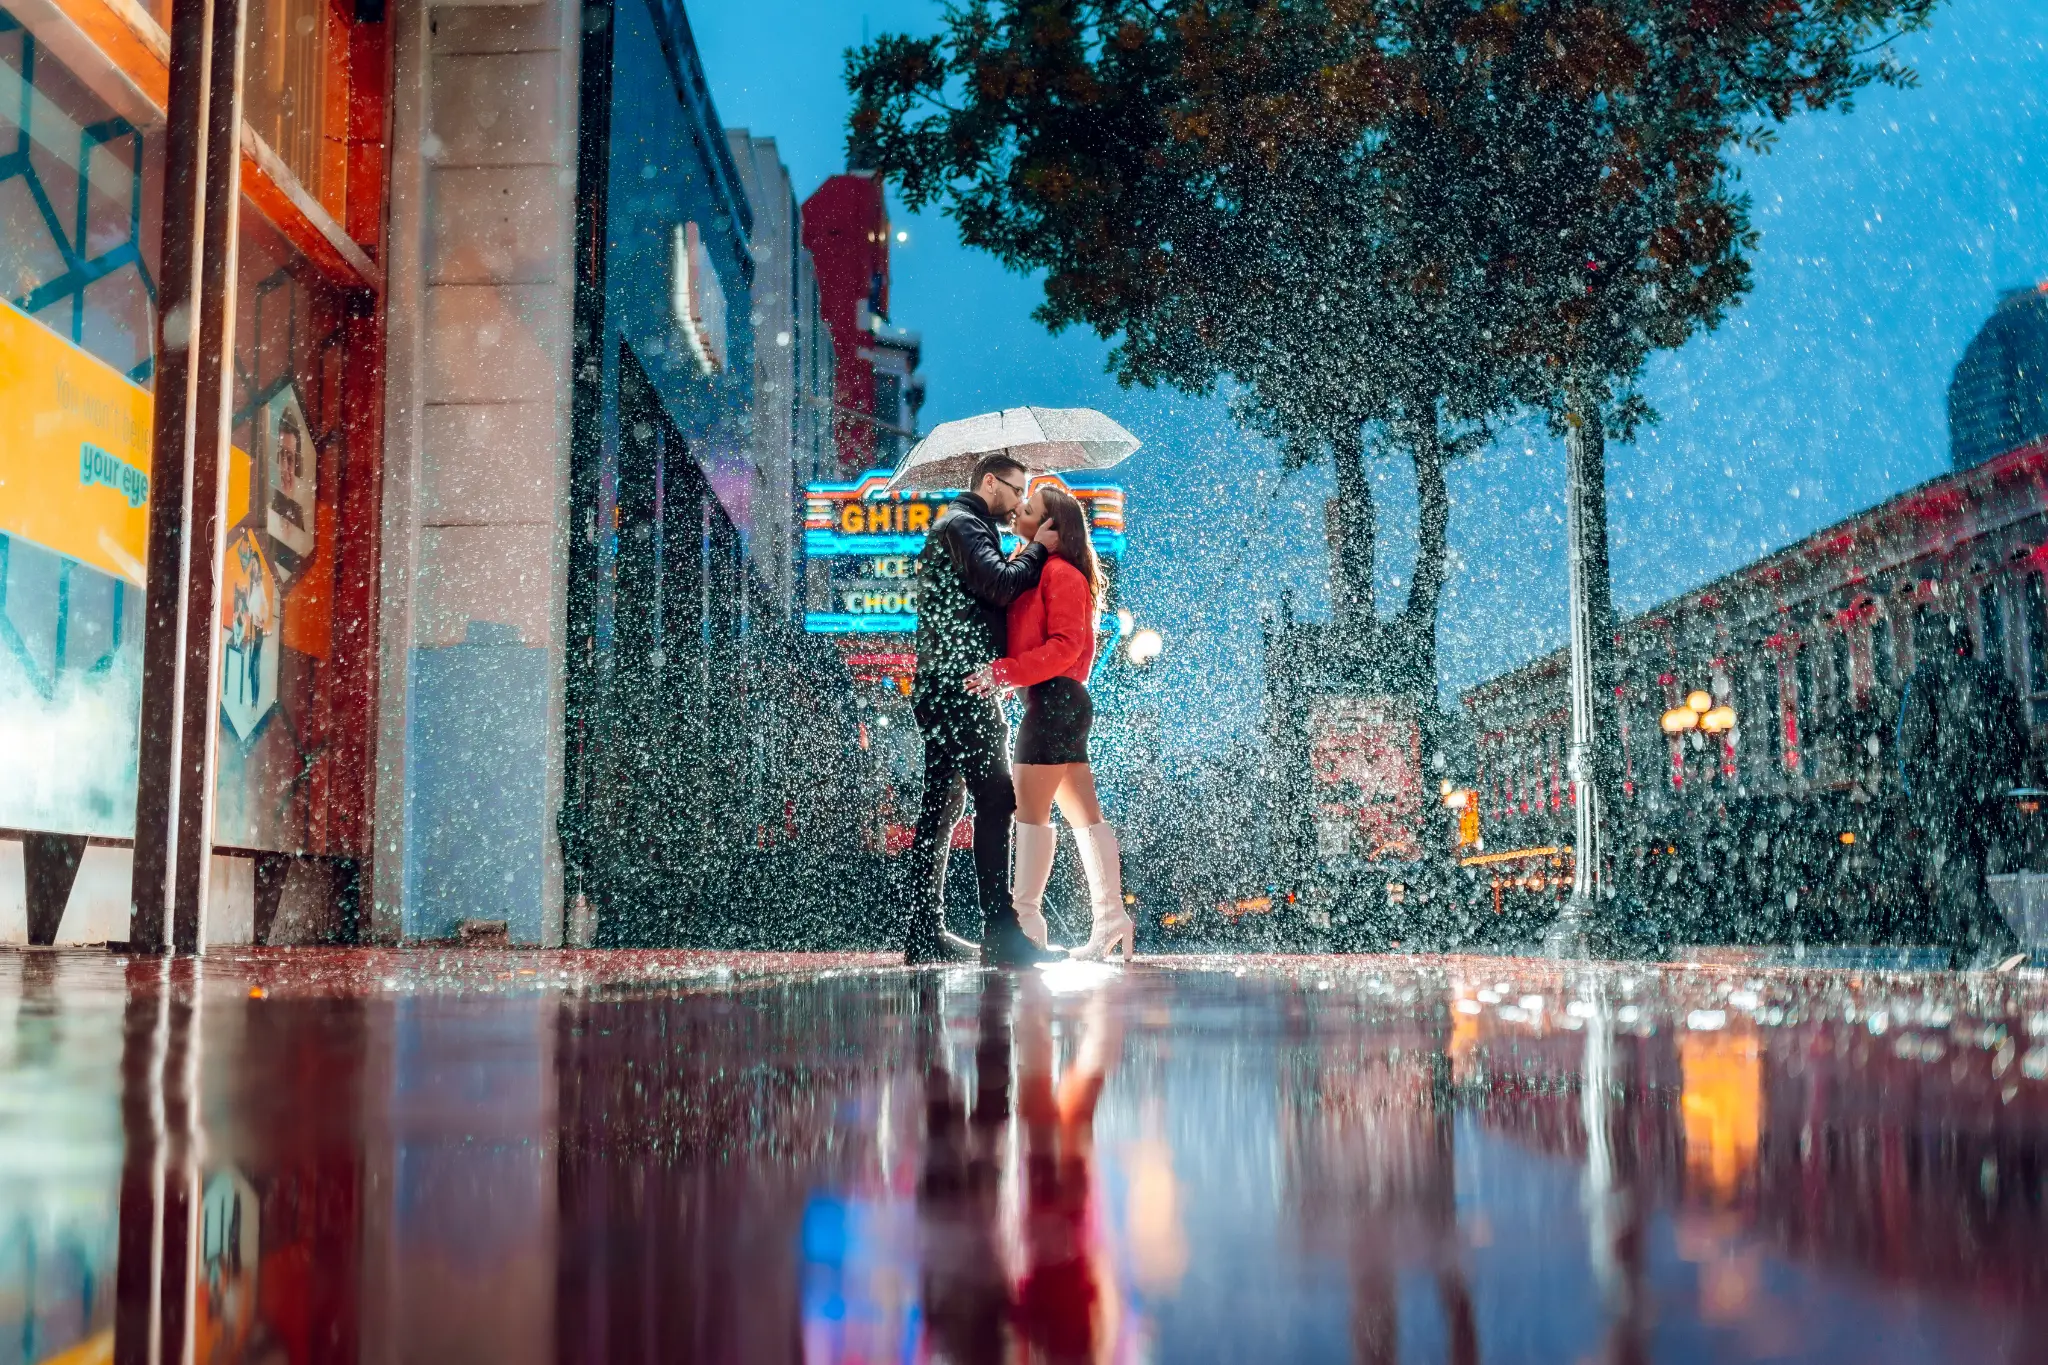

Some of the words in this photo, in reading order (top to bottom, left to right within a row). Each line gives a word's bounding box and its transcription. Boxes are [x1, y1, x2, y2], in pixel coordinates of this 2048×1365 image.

[55, 365, 79, 414] You
[83, 392, 120, 437] won't
[82, 444, 120, 486] your
[875, 556, 909, 578] ICE
